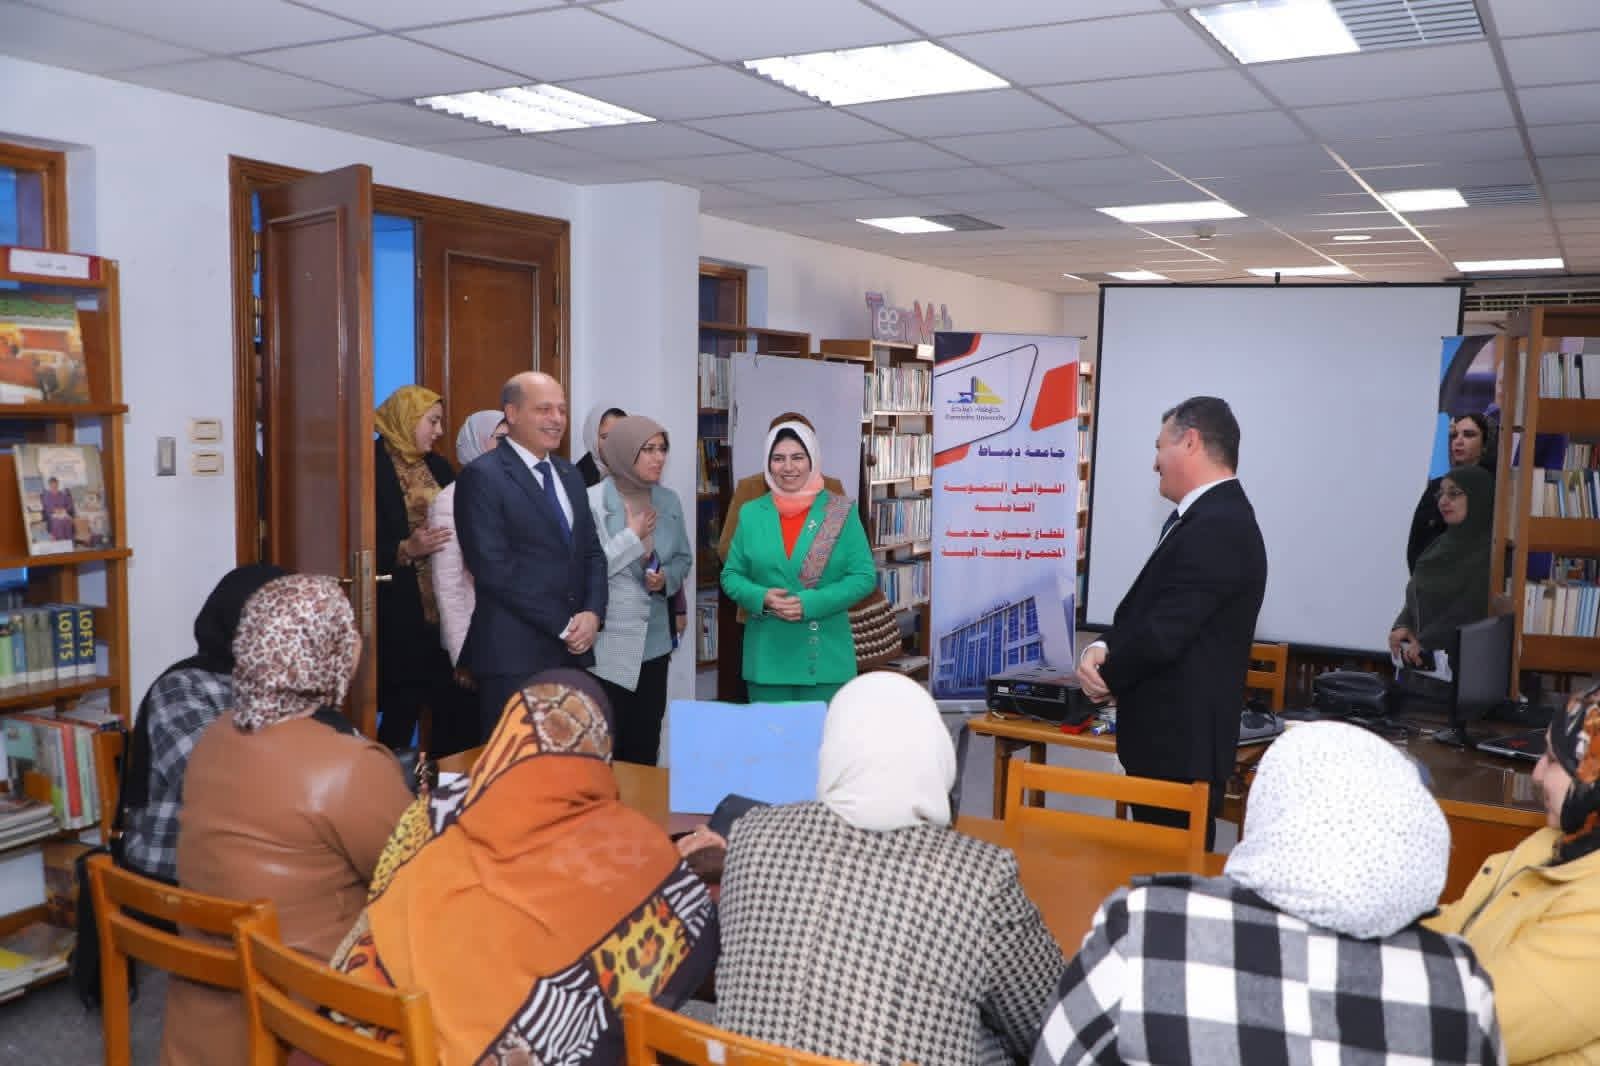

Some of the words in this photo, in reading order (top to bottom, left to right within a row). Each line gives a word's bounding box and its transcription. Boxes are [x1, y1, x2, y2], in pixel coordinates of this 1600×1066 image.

[978, 445, 1021, 457] دمياط
[1025, 446, 1065, 458] جامعة
[59, 612, 74, 660] LOFTS
[80, 610, 94, 657] LOFTS
